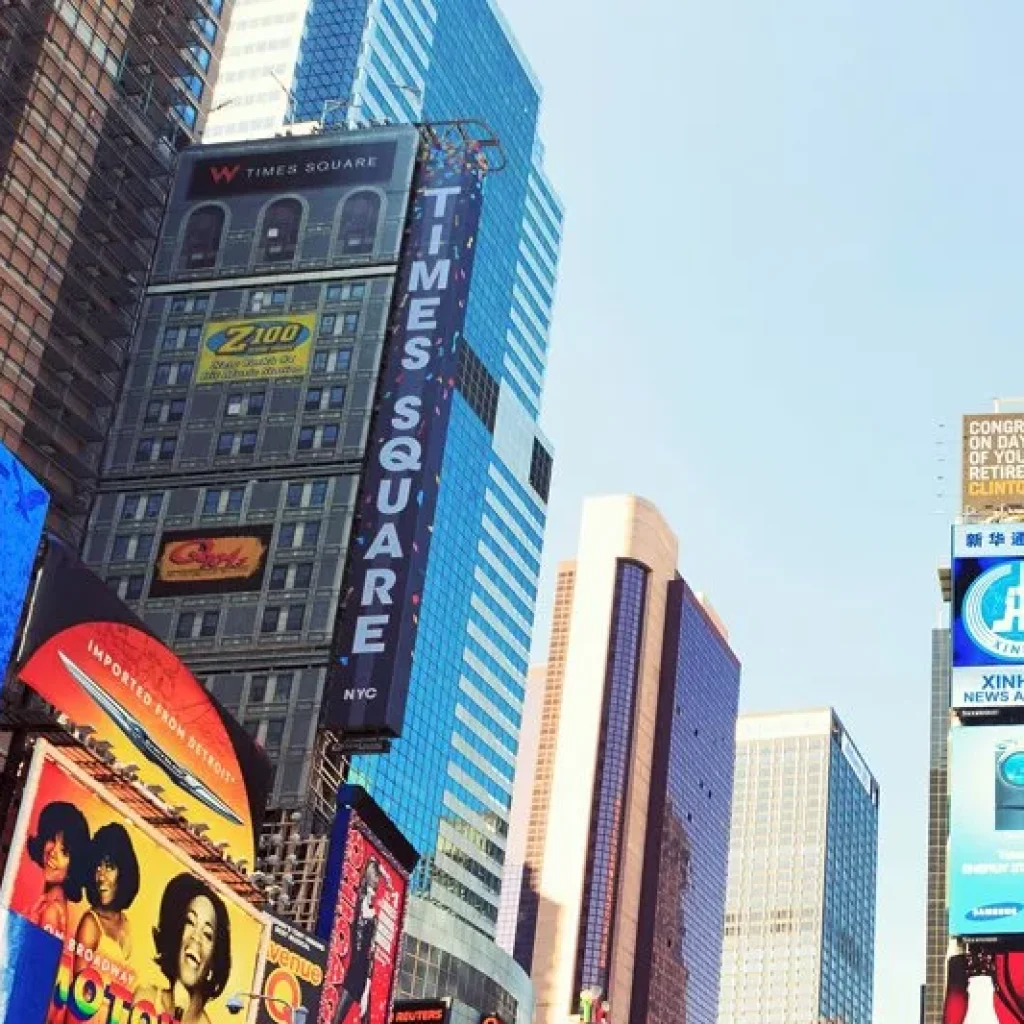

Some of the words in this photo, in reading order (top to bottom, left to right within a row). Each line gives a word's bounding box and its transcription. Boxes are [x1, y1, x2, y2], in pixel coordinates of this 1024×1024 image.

[209, 164, 241, 183] W
[246, 165, 298, 178] TIMES
[305, 156, 378, 172] SQUARE
[401, 187, 462, 370] TIMES
[215, 324, 301, 354] Z100
[969, 436, 992, 449] ON
[969, 451, 989, 464] OF
[352, 395, 421, 655] SQUARE
[87, 639, 153, 706] IMPORTED
[155, 704, 186, 740] FROM
[344, 687, 377, 700] NYC
[964, 691, 1009, 703] NEWS
[67, 938, 136, 984] BROADWAY
[267, 941, 323, 986] venue
